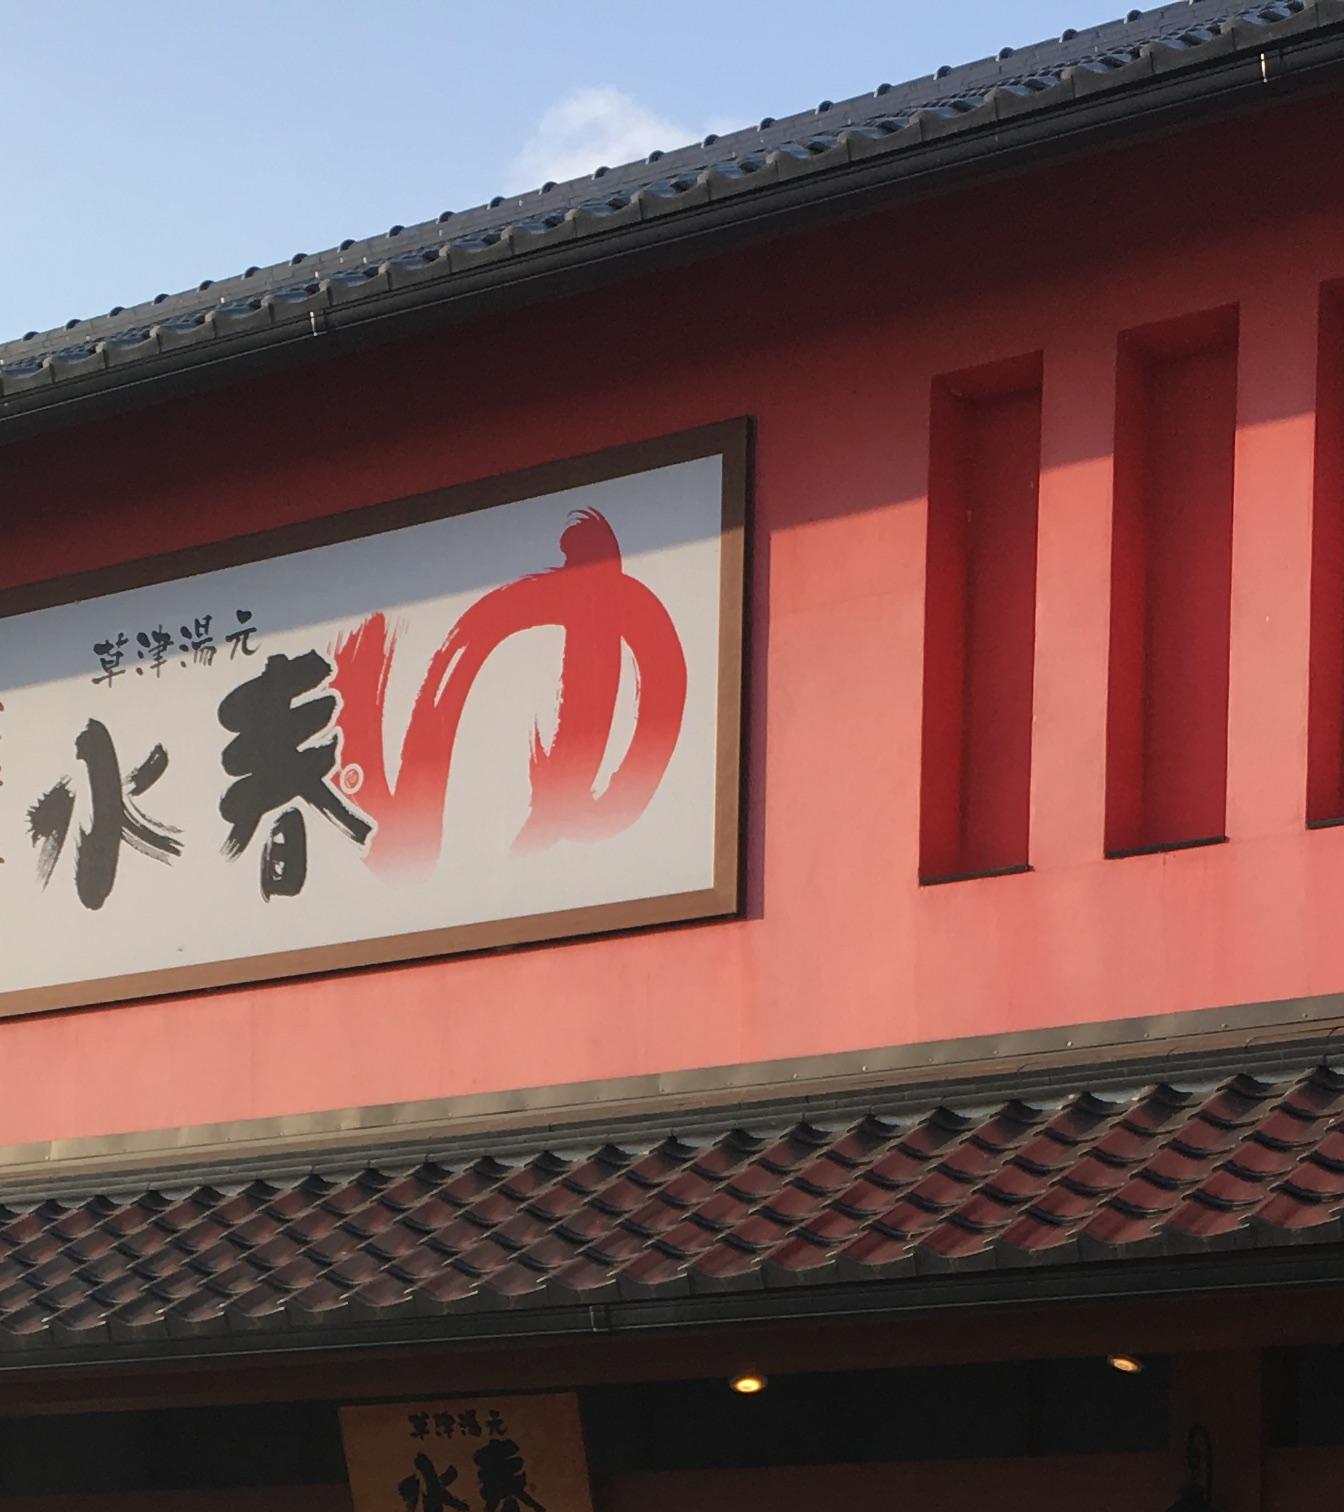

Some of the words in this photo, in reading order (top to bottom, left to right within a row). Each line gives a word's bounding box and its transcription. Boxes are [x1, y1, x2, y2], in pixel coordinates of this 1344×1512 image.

[25, 648, 376, 911] 水春
[90, 608, 263, 688] 草津湯元
[330, 506, 688, 889] ゆ
